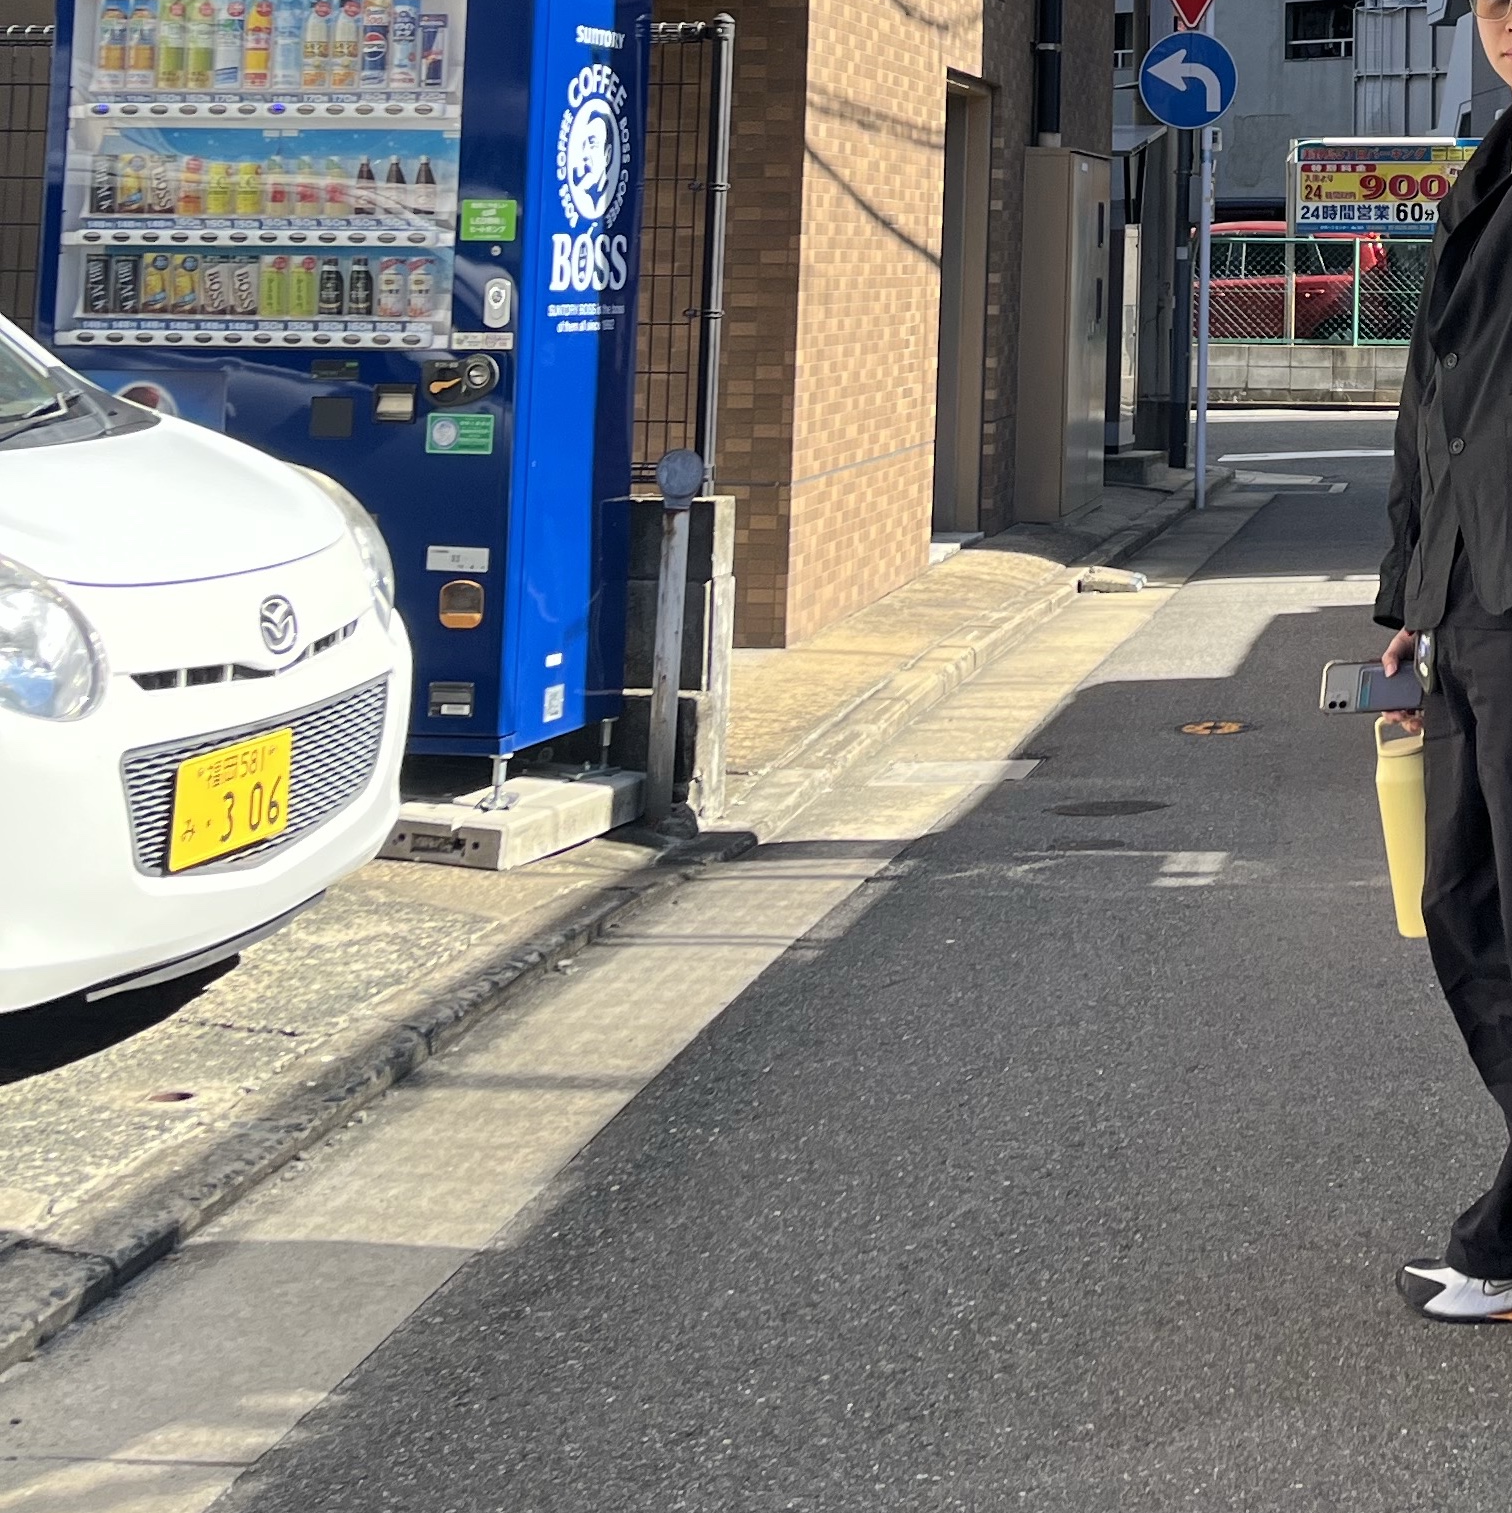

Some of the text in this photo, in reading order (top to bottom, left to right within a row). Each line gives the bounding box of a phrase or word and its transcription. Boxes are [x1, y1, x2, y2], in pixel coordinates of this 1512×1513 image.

[575, 24, 626, 50] SUNTORY
[567, 63, 628, 115] COFFEE
[1359, 174, 1451, 201] 900
[1300, 204, 1390, 221] 24時間営業
[1396, 203, 1435, 222] 60分
[550, 232, 628, 292] BOSS
